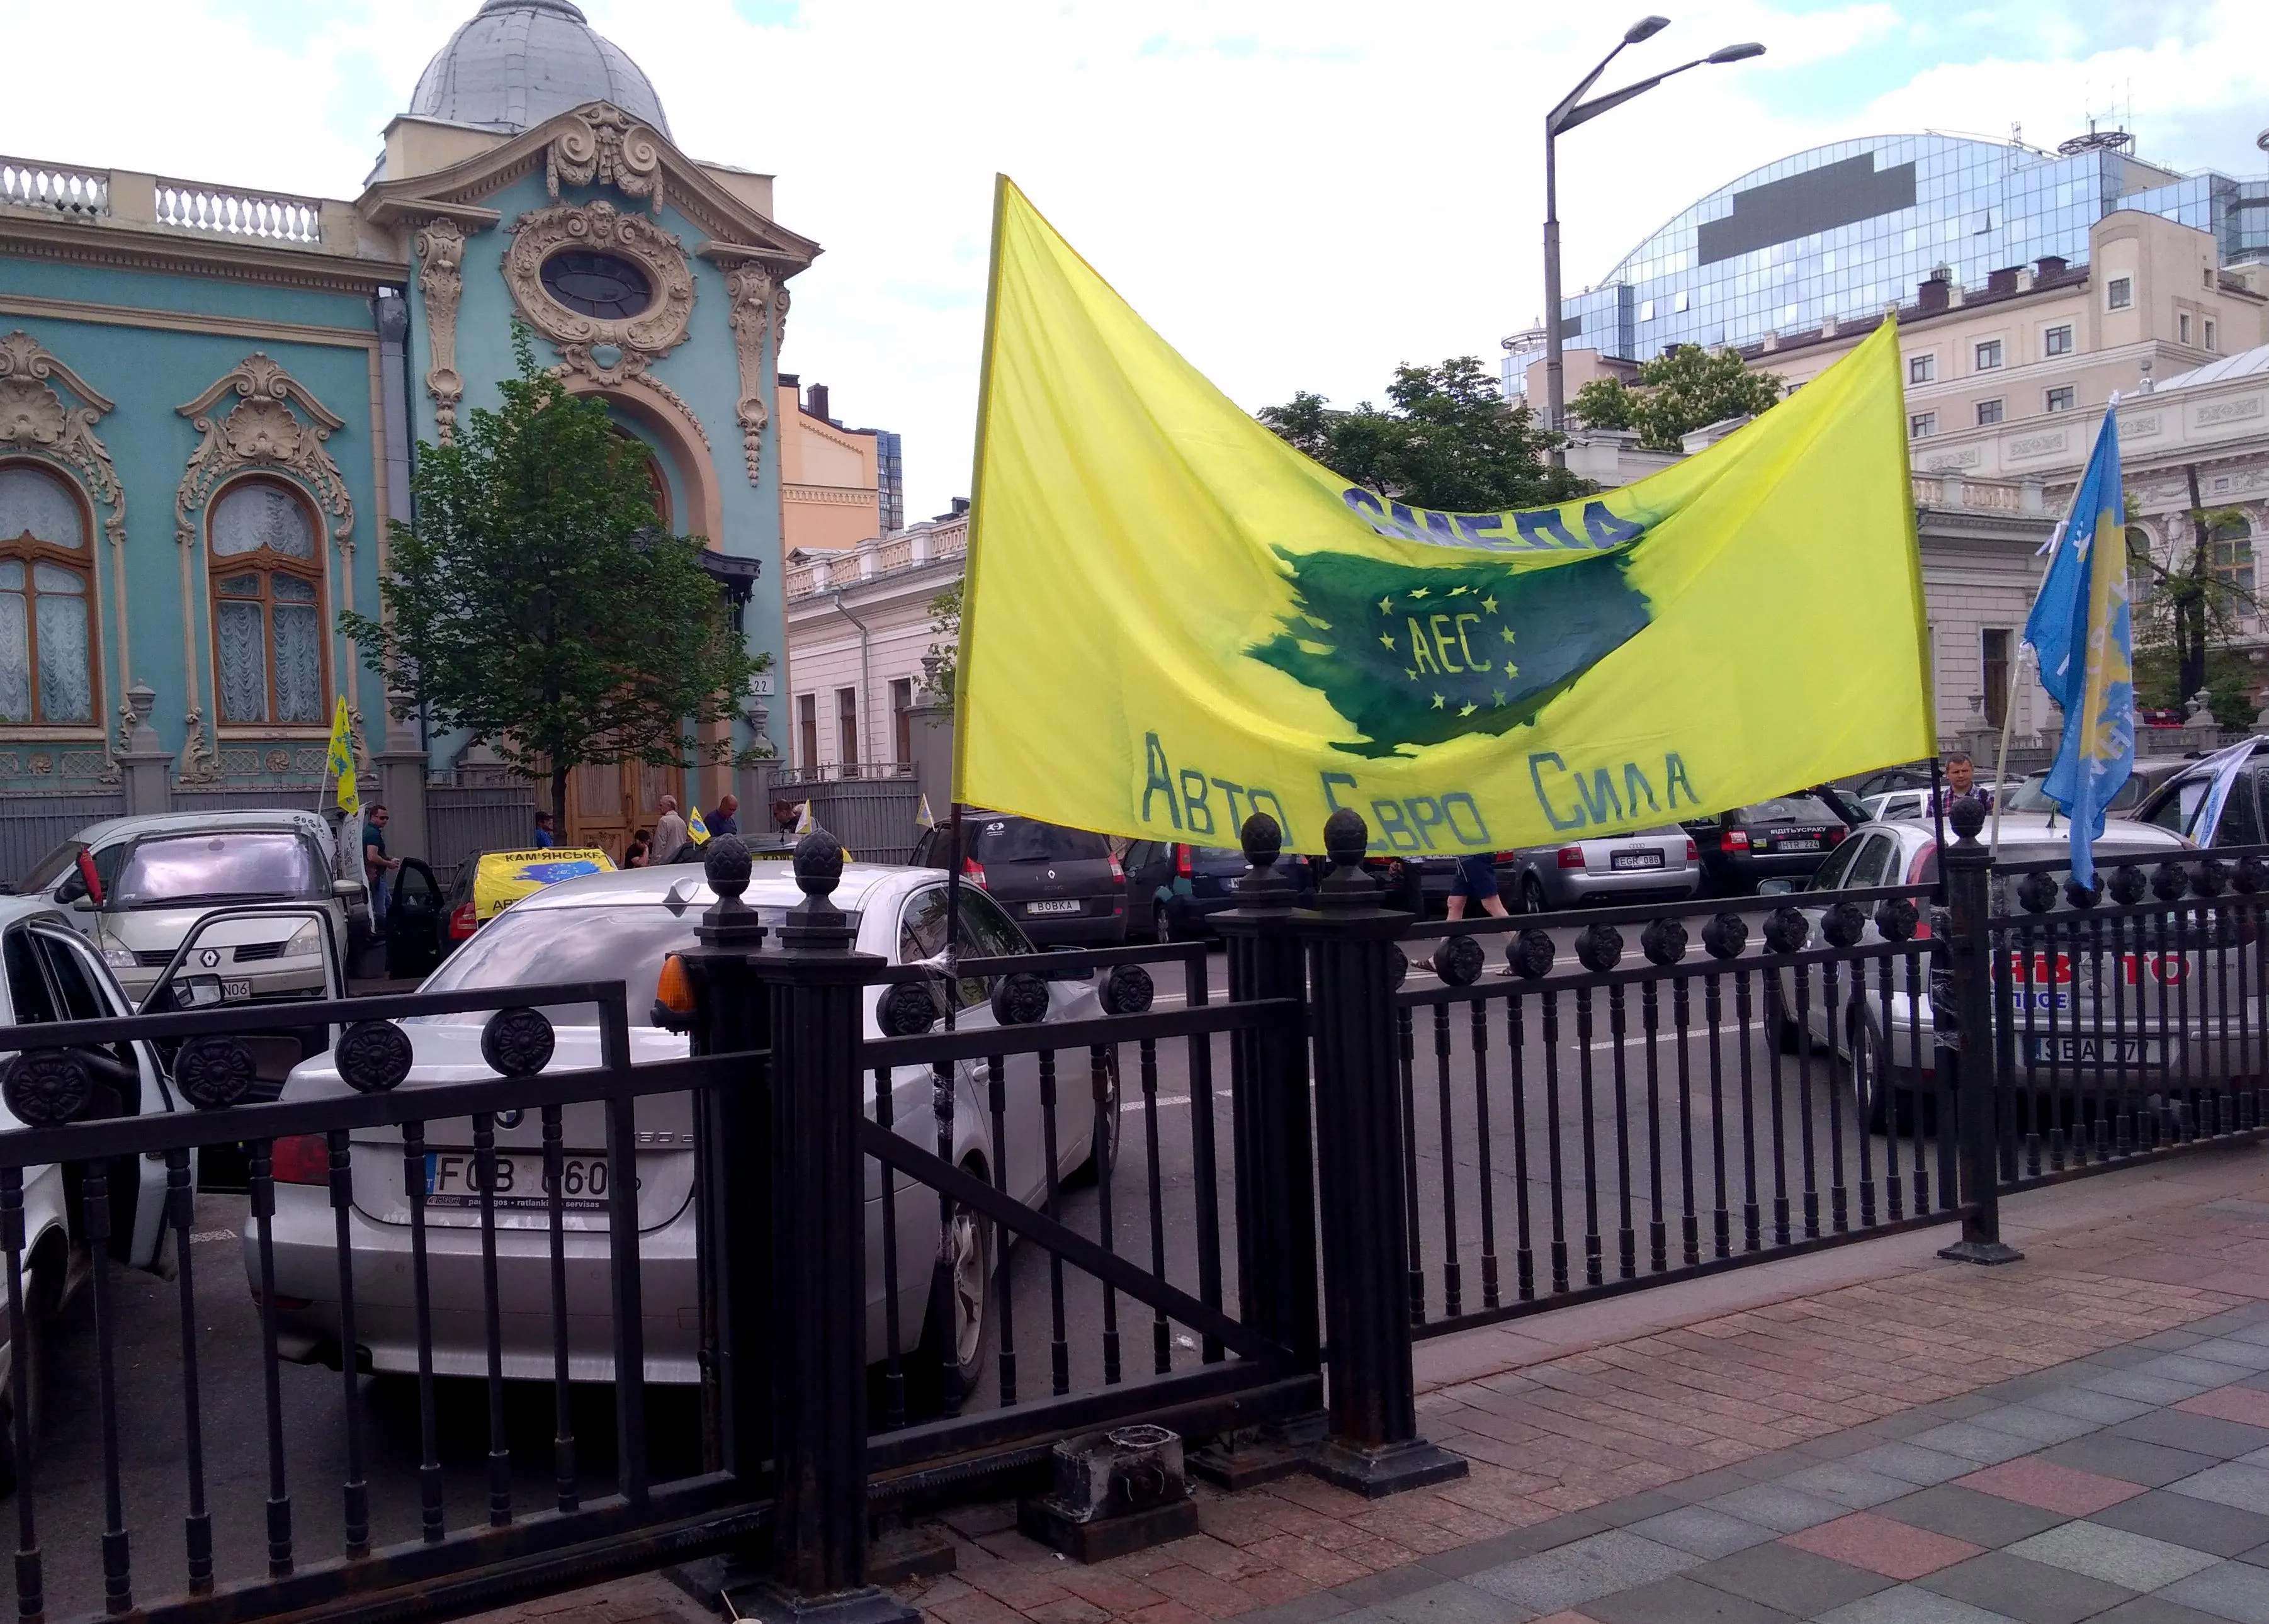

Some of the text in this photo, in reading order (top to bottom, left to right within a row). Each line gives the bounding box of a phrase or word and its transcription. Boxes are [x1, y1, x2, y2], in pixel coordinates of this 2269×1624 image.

[754, 680, 767, 692] 22
[1528, 752, 1701, 831] СИЛА
[1782, 840, 1818, 849] HTR 224
[1620, 855, 1659, 866] EGR 086
[541, 1161, 608, 1195] 60
[468, 1198, 507, 1207] pagos
